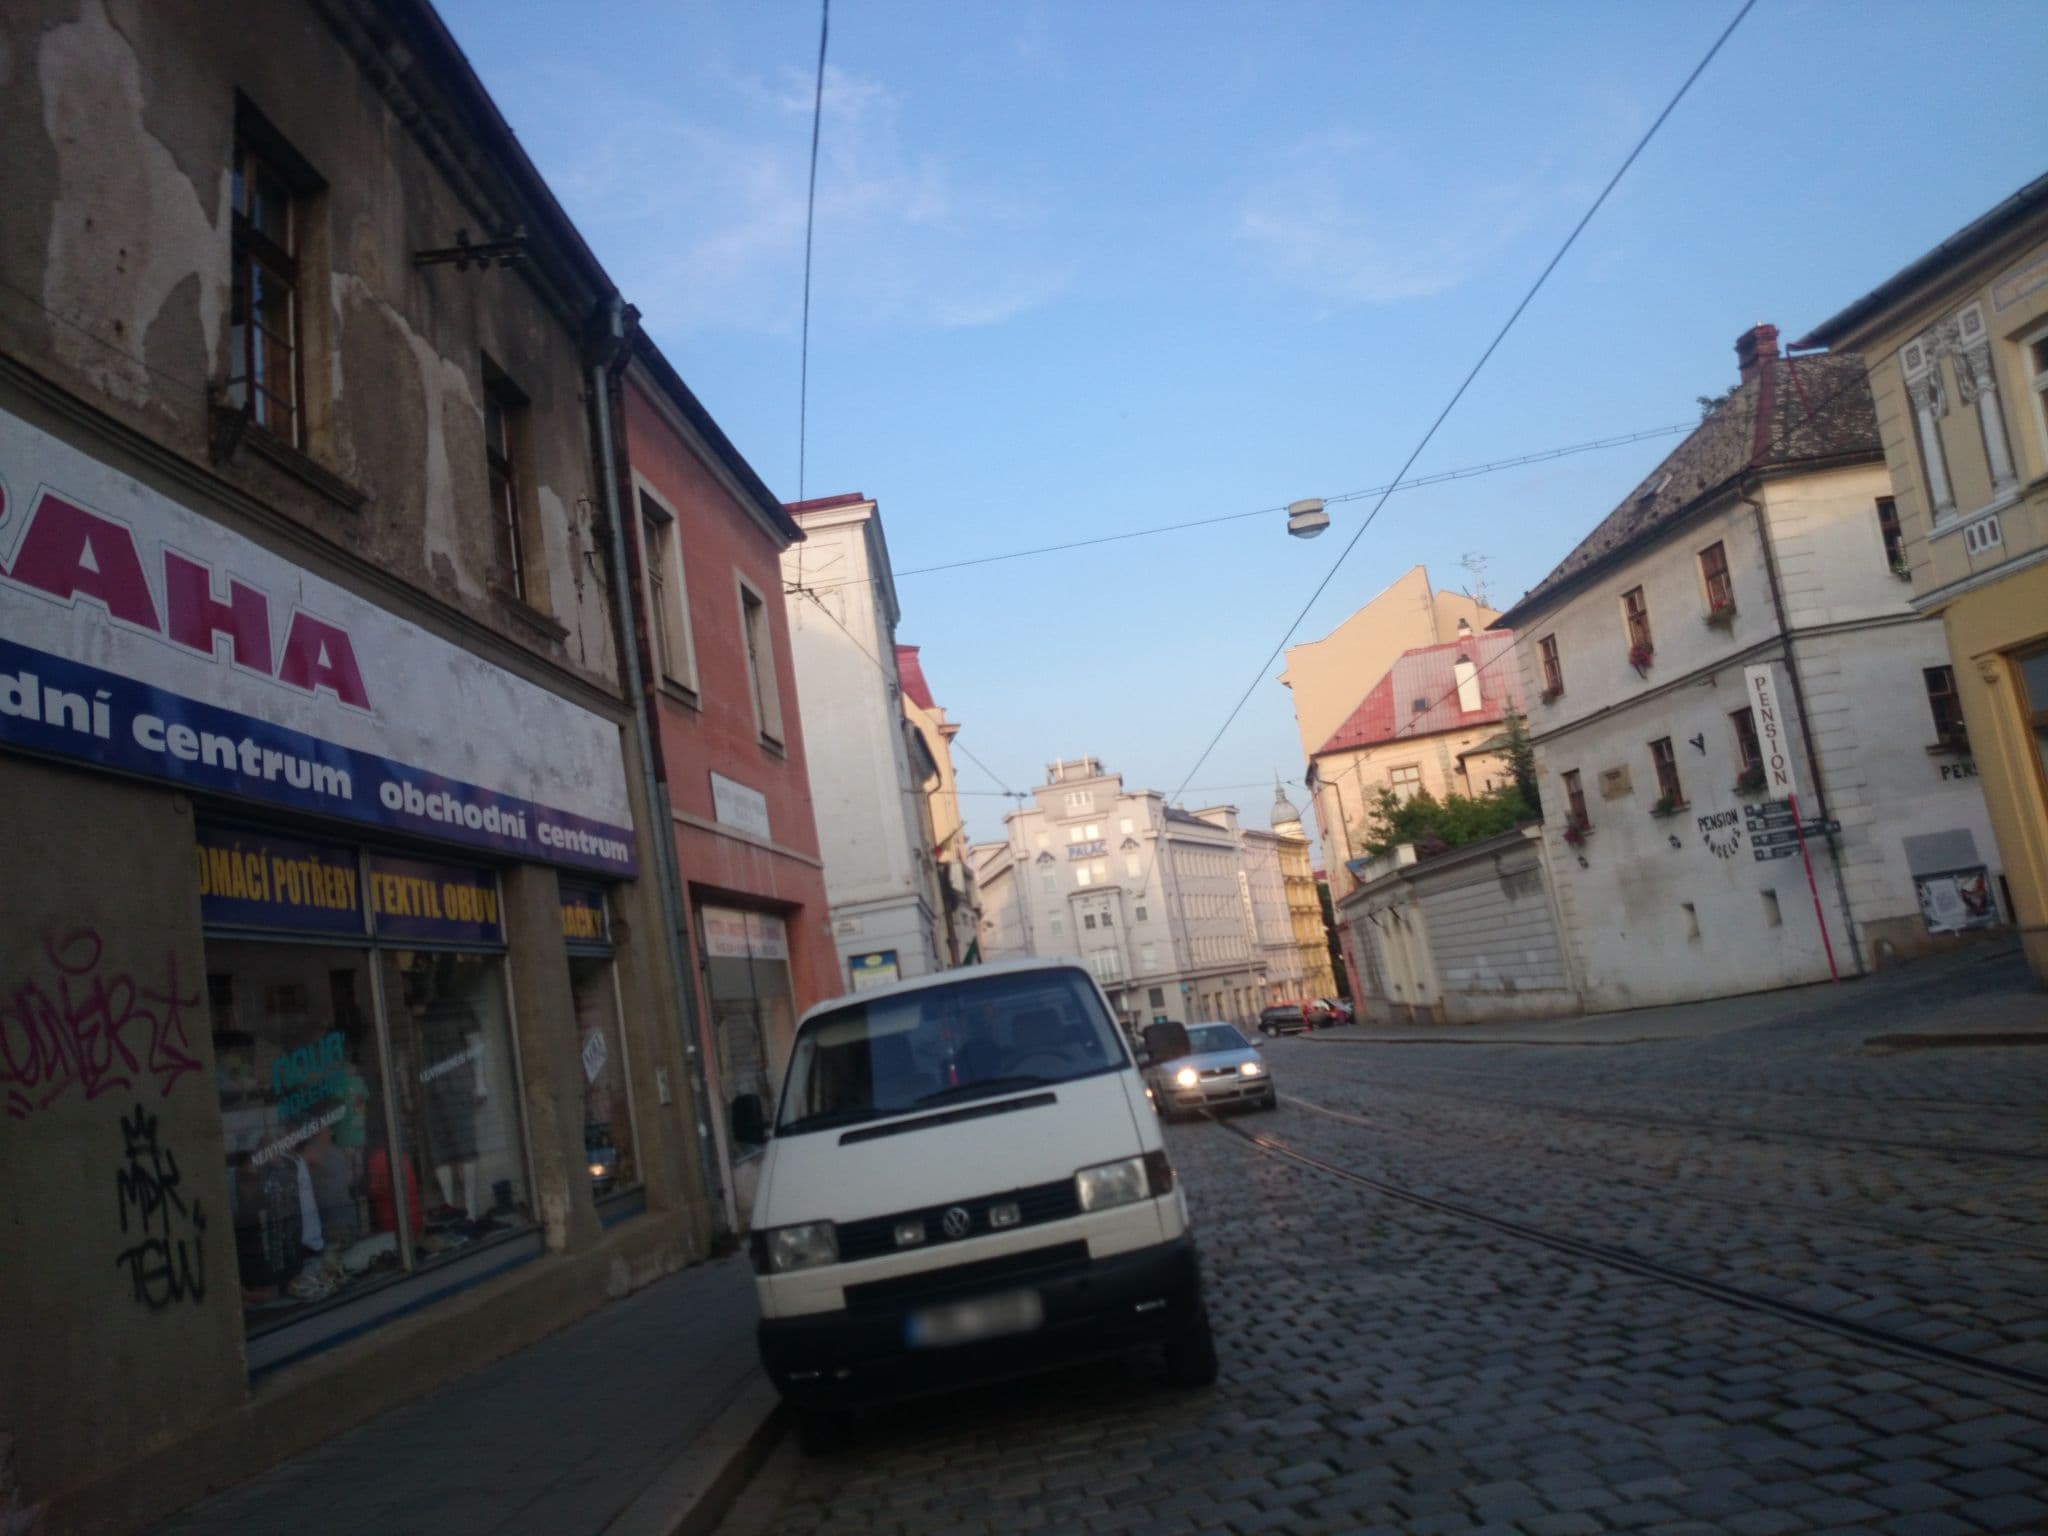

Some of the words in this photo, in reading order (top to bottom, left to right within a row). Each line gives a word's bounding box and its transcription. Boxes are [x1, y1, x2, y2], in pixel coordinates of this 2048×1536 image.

[0, 482, 372, 713] AHA
[1754, 676, 1787, 786] PENSION
[132, 712, 352, 801] centrum
[380, 778, 527, 840] obchodní
[538, 822, 629, 864] centrum
[1697, 808, 1739, 833] PENSION
[272, 856, 357, 911] POTŘEBY
[369, 872, 441, 920] TEXTIL
[443, 883, 498, 925] OBUV
